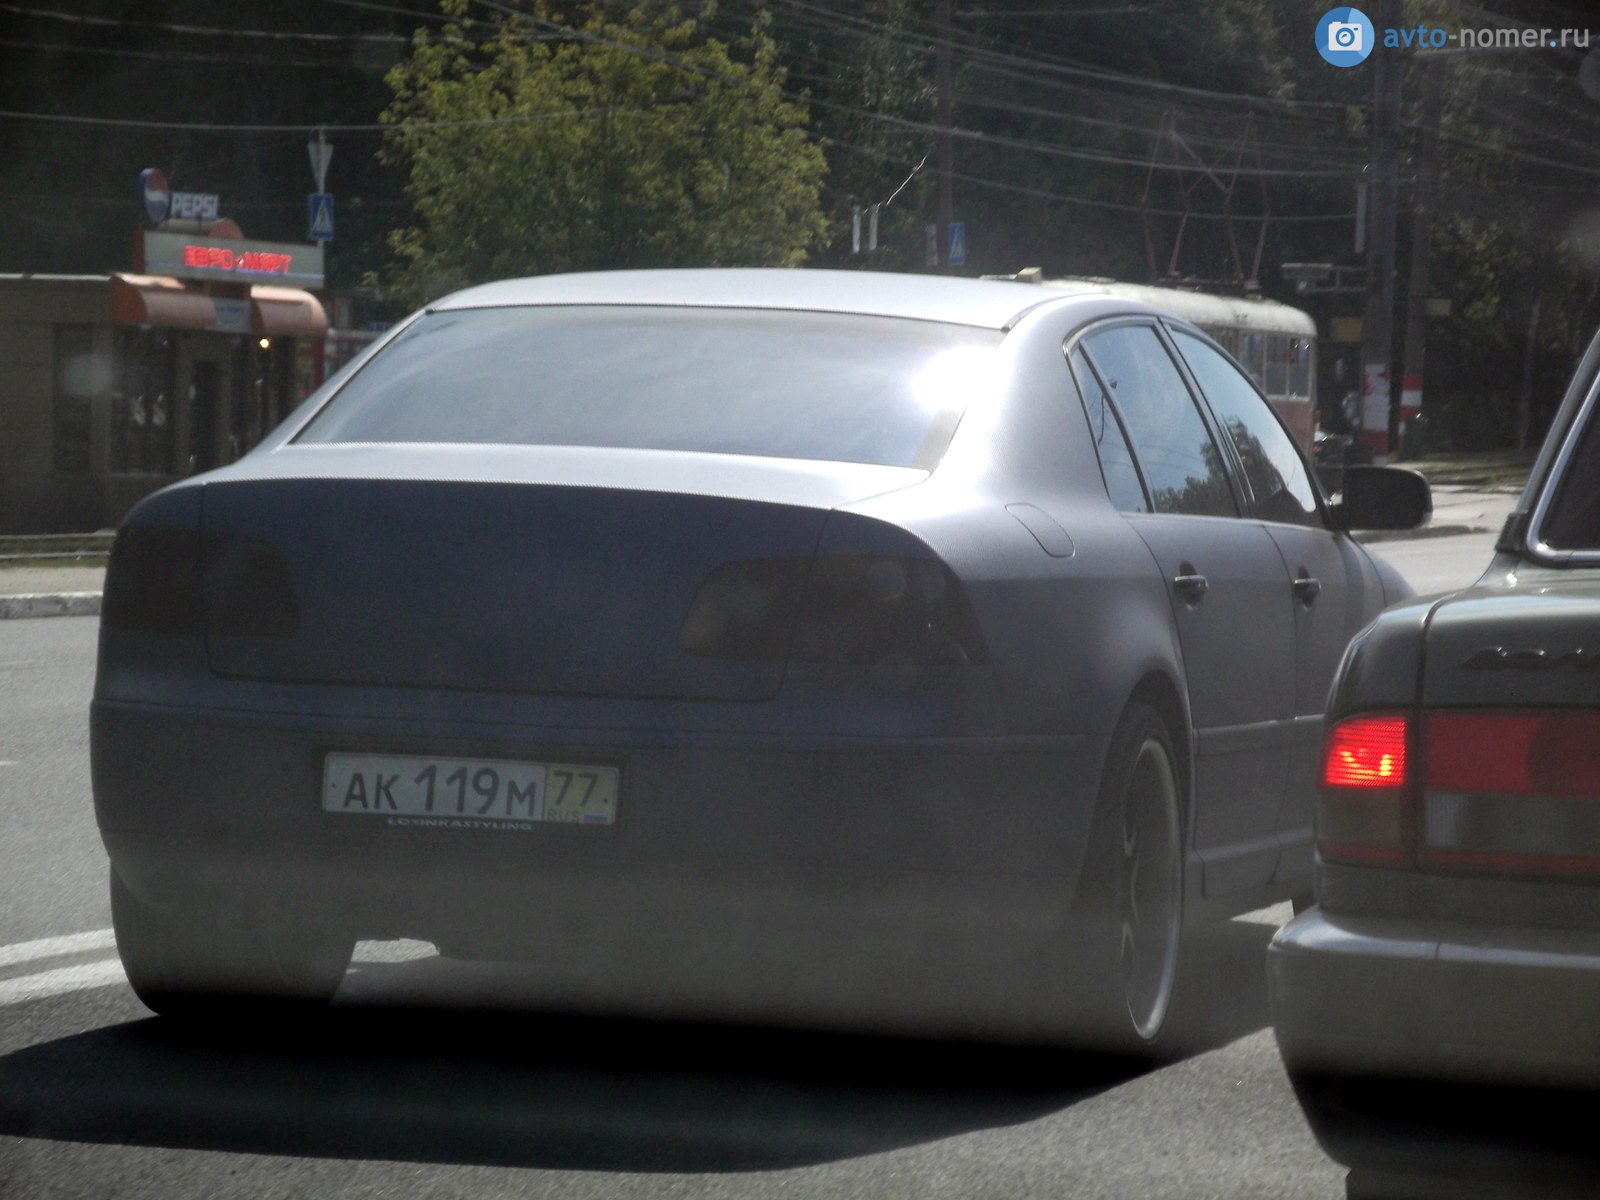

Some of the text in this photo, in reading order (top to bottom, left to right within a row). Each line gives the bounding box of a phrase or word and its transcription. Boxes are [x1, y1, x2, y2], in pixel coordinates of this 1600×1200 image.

[171, 192, 219, 219] PEPSI
[553, 771, 598, 808] 77
[547, 808, 579, 823] RUS
